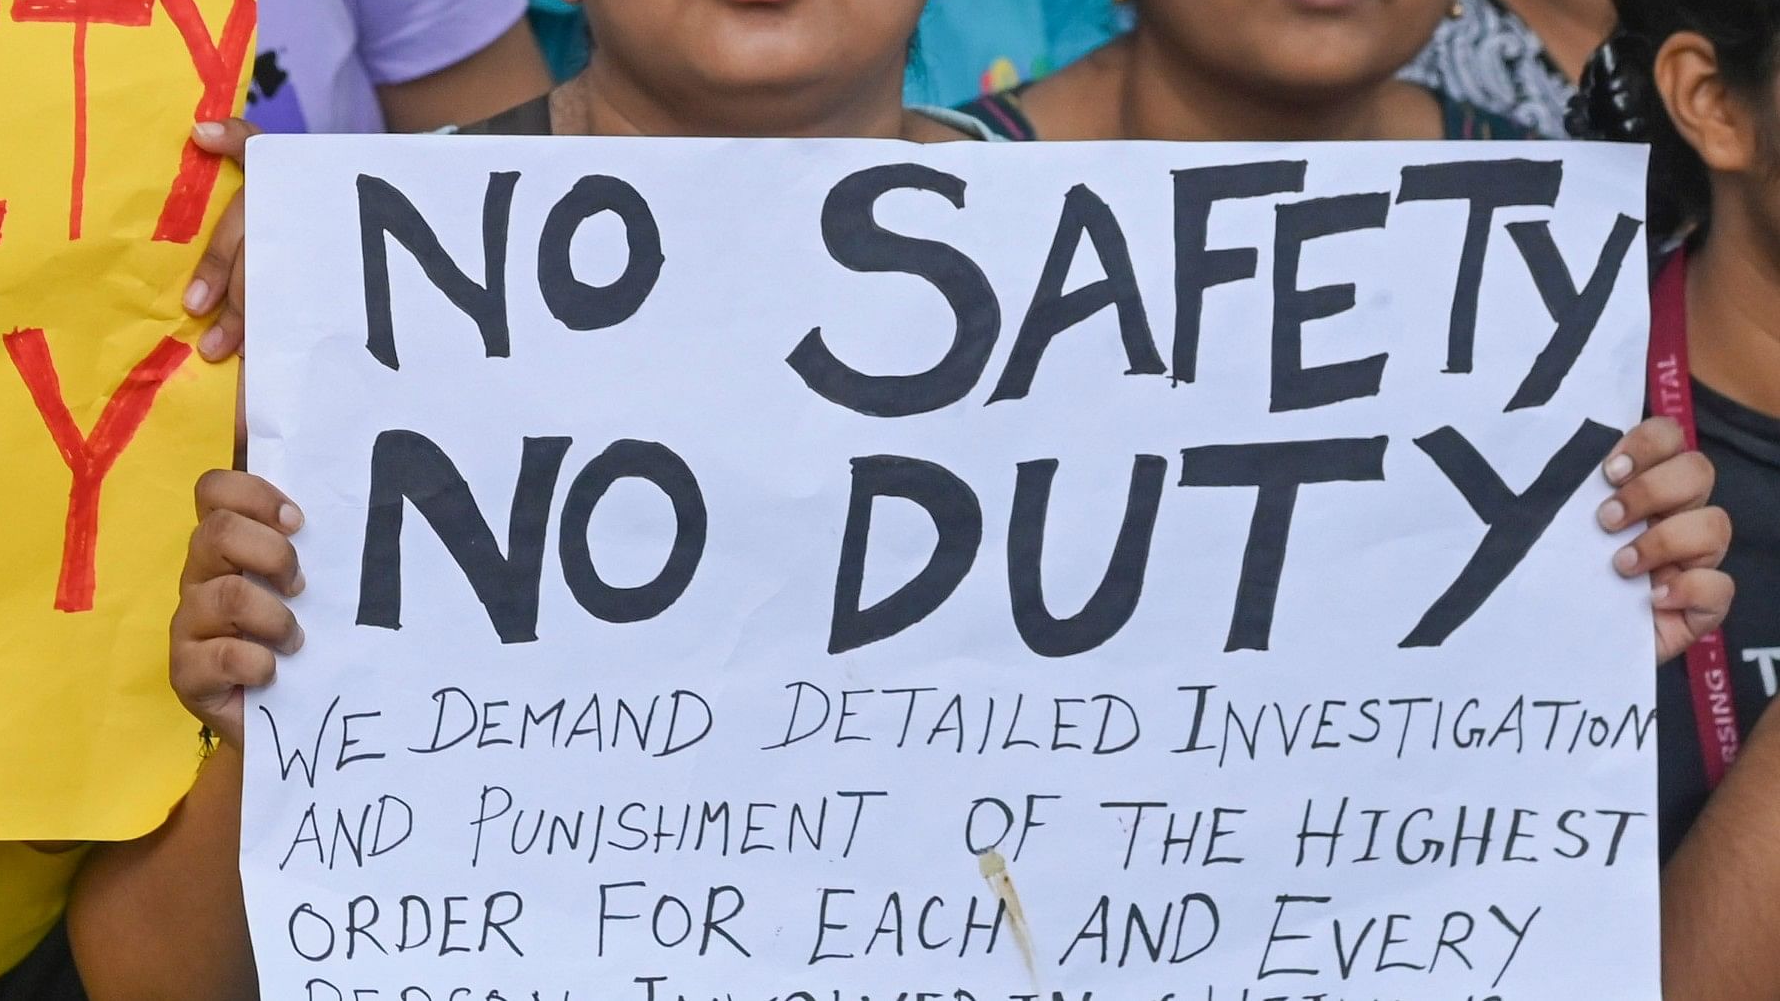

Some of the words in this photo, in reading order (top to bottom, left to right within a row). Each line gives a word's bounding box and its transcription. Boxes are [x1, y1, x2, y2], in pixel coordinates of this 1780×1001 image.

[356, 171, 665, 371] NO
[785, 159, 1643, 418] SAFETY
[356, 430, 707, 644] NO
[828, 418, 1624, 656] DUTY
[260, 695, 386, 787] WE
[407, 687, 713, 757] DEMAND
[761, 682, 1139, 755] DETAILED
[1171, 684, 1657, 766] INVESTIGATION
[279, 795, 412, 870] AND
[470, 786, 888, 867] PUNISHMENT
[965, 795, 1061, 862] OF
[1100, 801, 1246, 870] THE
[1296, 797, 1649, 867] HIGHEST
[288, 891, 524, 961] ORDER
[598, 881, 751, 958] FOR
[810, 888, 1007, 966] EACH
[1059, 894, 1220, 967] AND
[1257, 894, 1541, 989] EVERY
